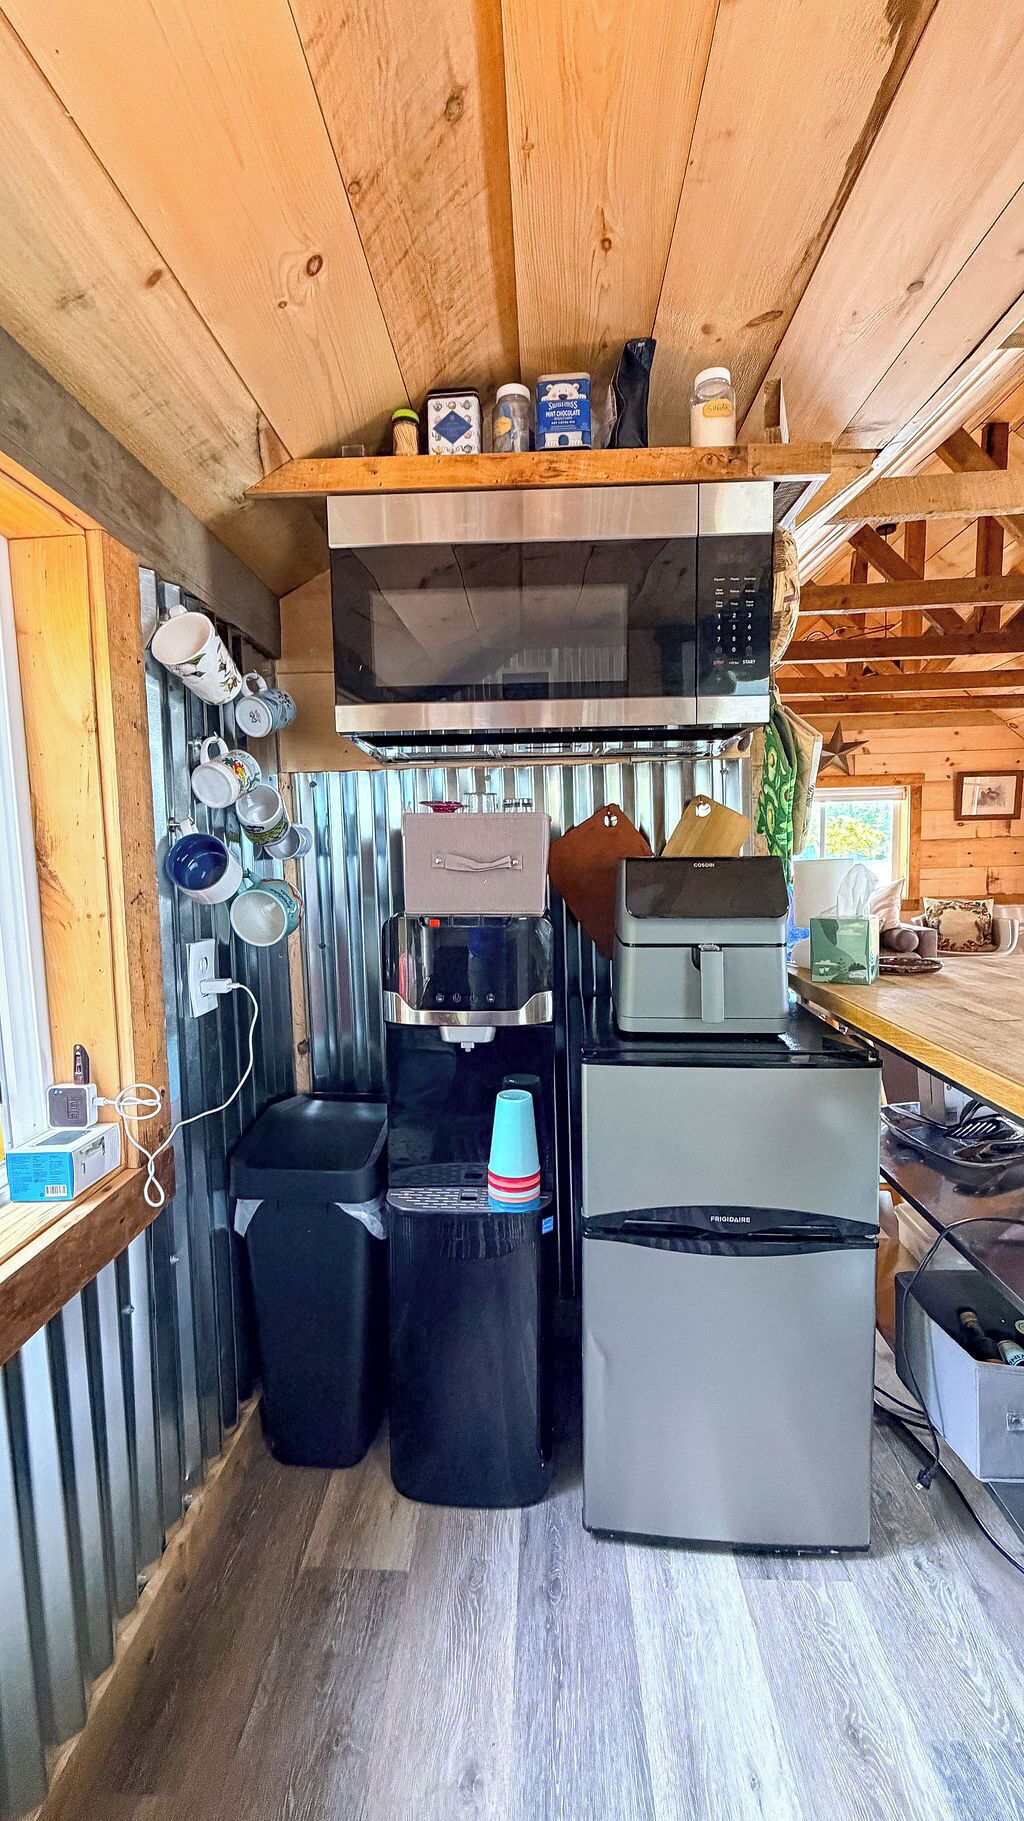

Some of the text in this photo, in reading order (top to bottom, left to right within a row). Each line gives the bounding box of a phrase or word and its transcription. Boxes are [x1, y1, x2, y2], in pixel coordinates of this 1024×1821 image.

[545, 410, 556, 418] MINT
[556, 409, 580, 417] CHOCOLATE
[710, 1215, 751, 1223] FRIGIDAIRE
